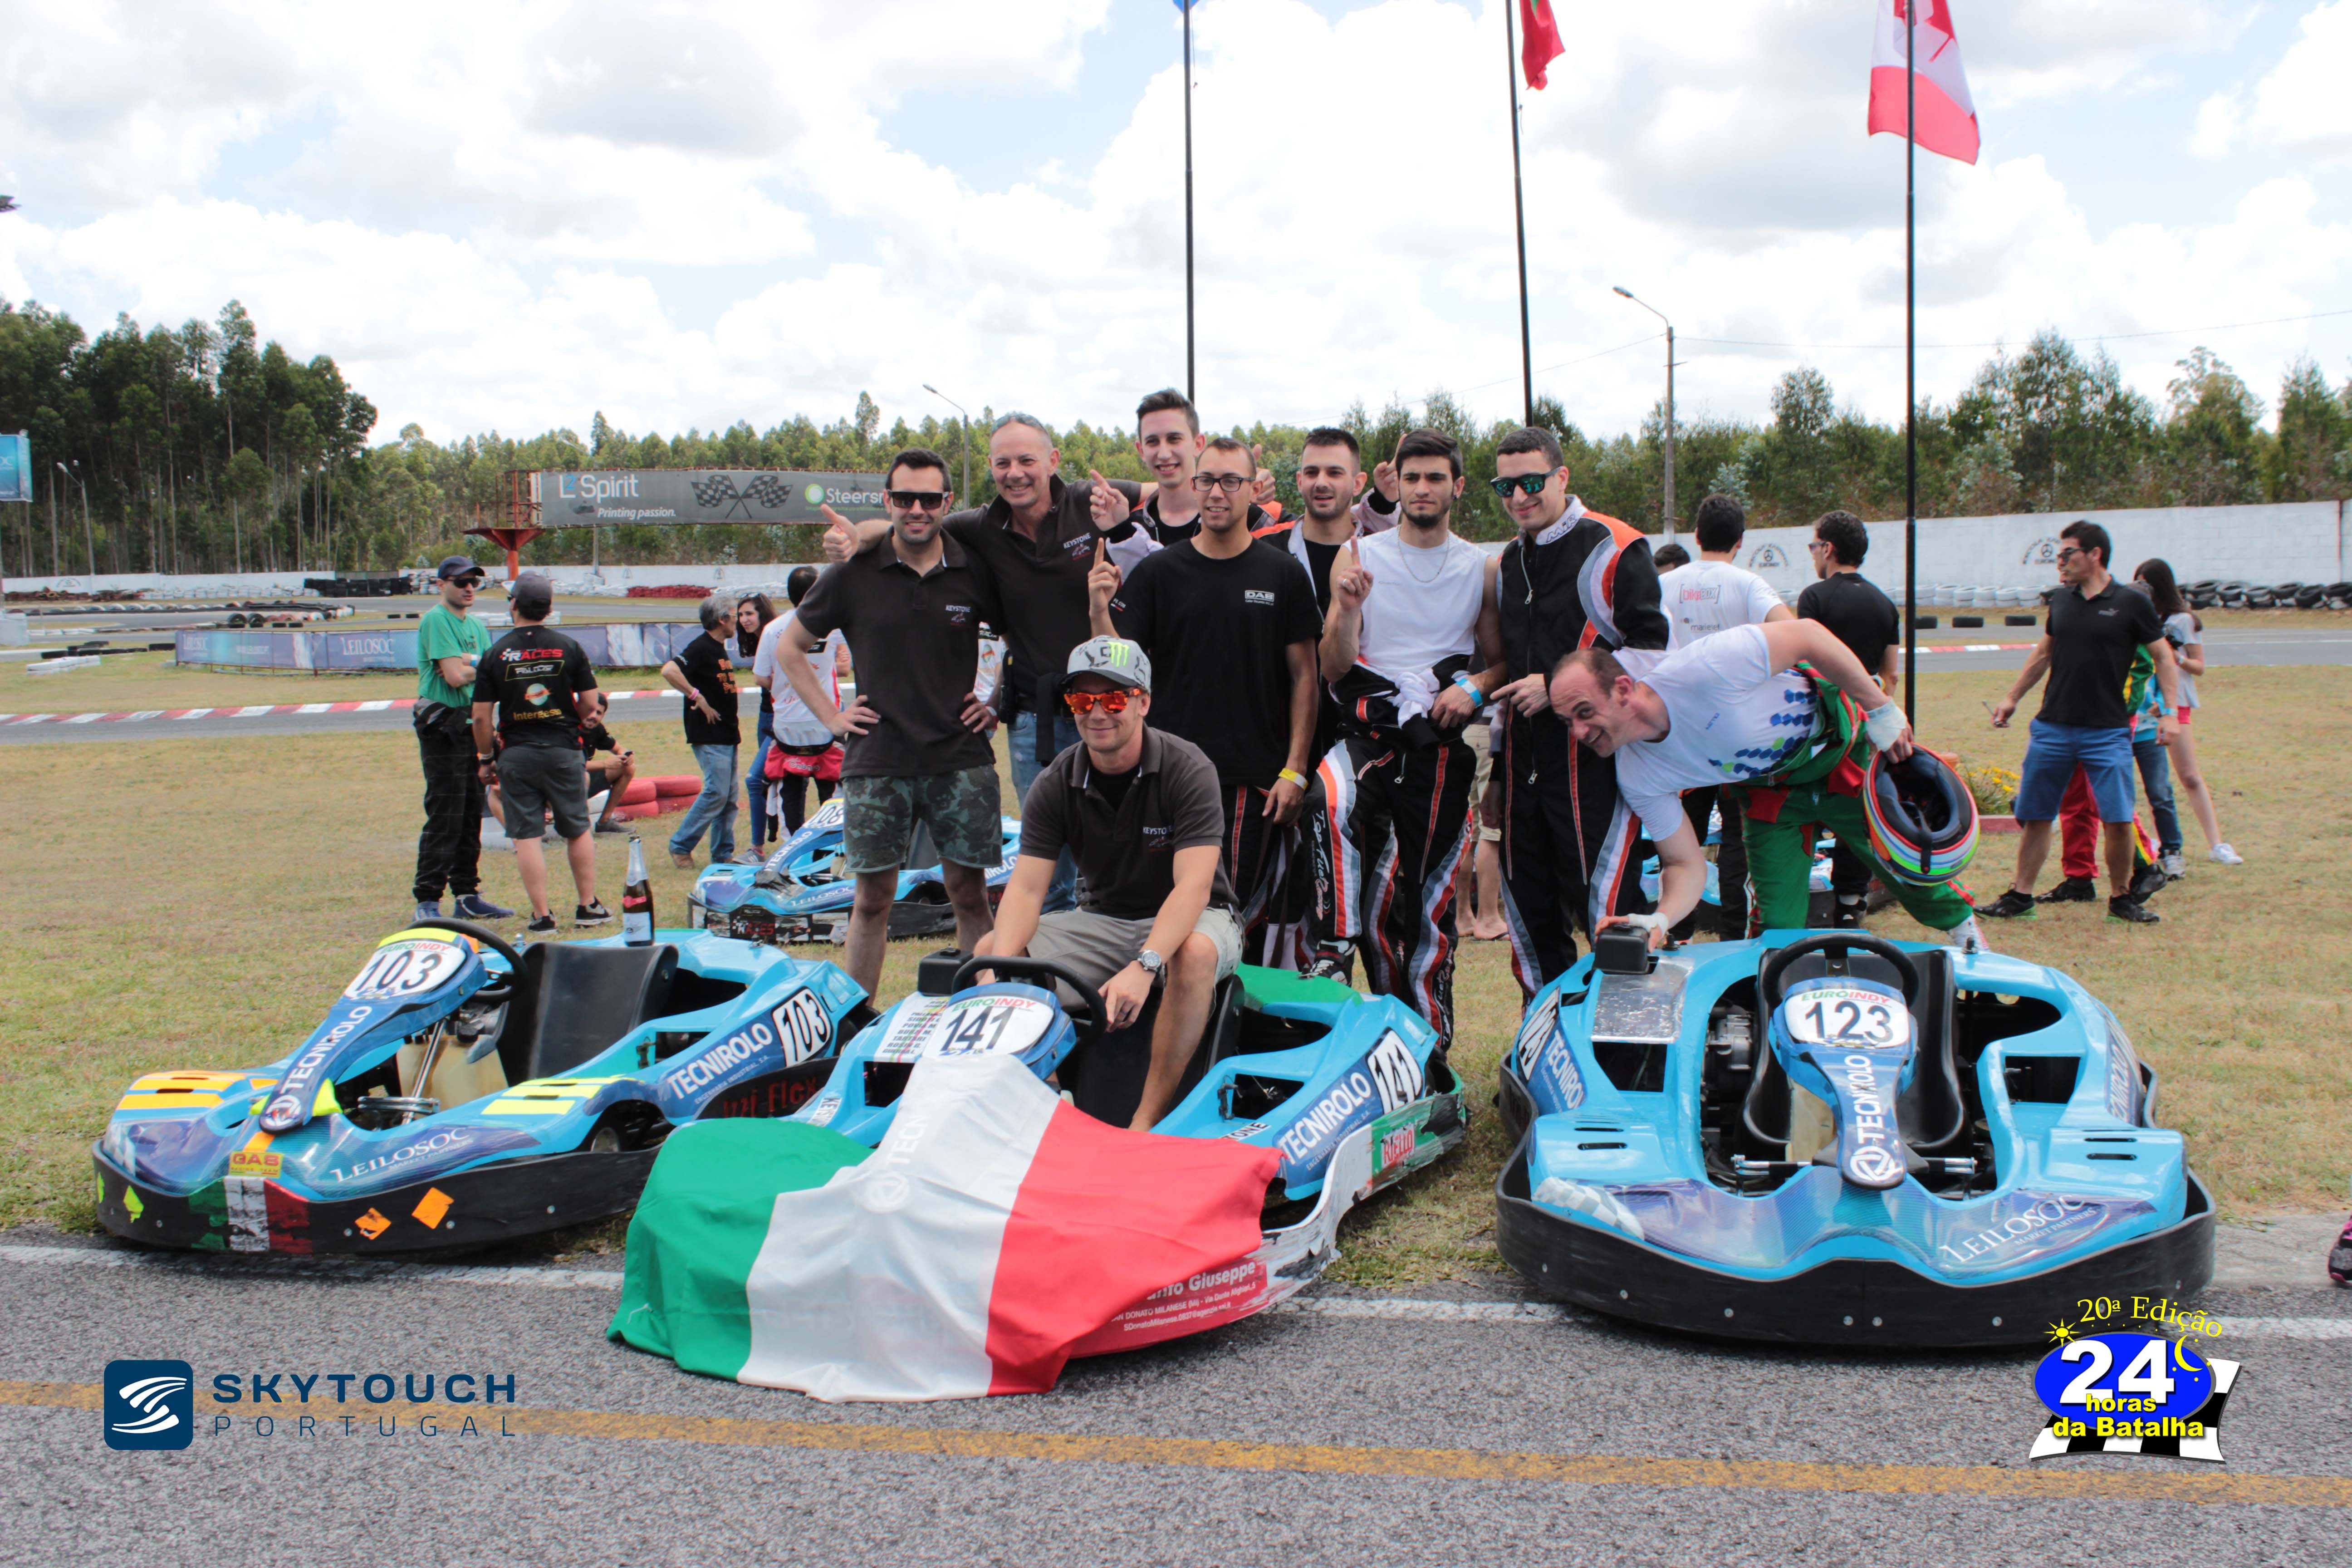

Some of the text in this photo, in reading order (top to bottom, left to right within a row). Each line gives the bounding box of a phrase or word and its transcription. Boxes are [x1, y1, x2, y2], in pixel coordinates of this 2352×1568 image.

[580, 474, 639, 504] Spirit
[598, 506, 676, 519] Printing passion.
[1063, 532, 1091, 549] KEYSTONE
[340, 637, 395, 656] LEILOSOC
[791, 886, 854, 906] LEILOSOC
[381, 943, 452, 953] EUROINDY
[356, 950, 443, 991] 103
[951, 998, 1037, 1012] EUROINDY
[1801, 990, 1891, 1004] EUROINDY
[782, 993, 828, 1062] 103
[940, 1005, 1015, 1052] 141
[1805, 1000, 1894, 1043] 123
[279, 1005, 372, 1094] TECNIROLO
[666, 1023, 773, 1099] TECNIROLO
[1373, 1044, 1416, 1112] 141
[1278, 1072, 1373, 1165] TECNIROLO
[1844, 1055, 1883, 1144] TECNIROLO
[329, 1127, 469, 1183] LEILOSOC
[387, 1139, 474, 1171] MARKET PARTNERS
[1939, 1194, 2085, 1263] LEILOSOC
[2014, 1207, 2097, 1245] MARKET PARTNERS
[1188, 1261, 1256, 1291] Giuseppe
[1126, 1308, 1154, 1320] DONATO
[1154, 1301, 1187, 1314] MILANESE
[1204, 1294, 1215, 1304] Via
[1214, 1290, 1230, 1302] Dante
